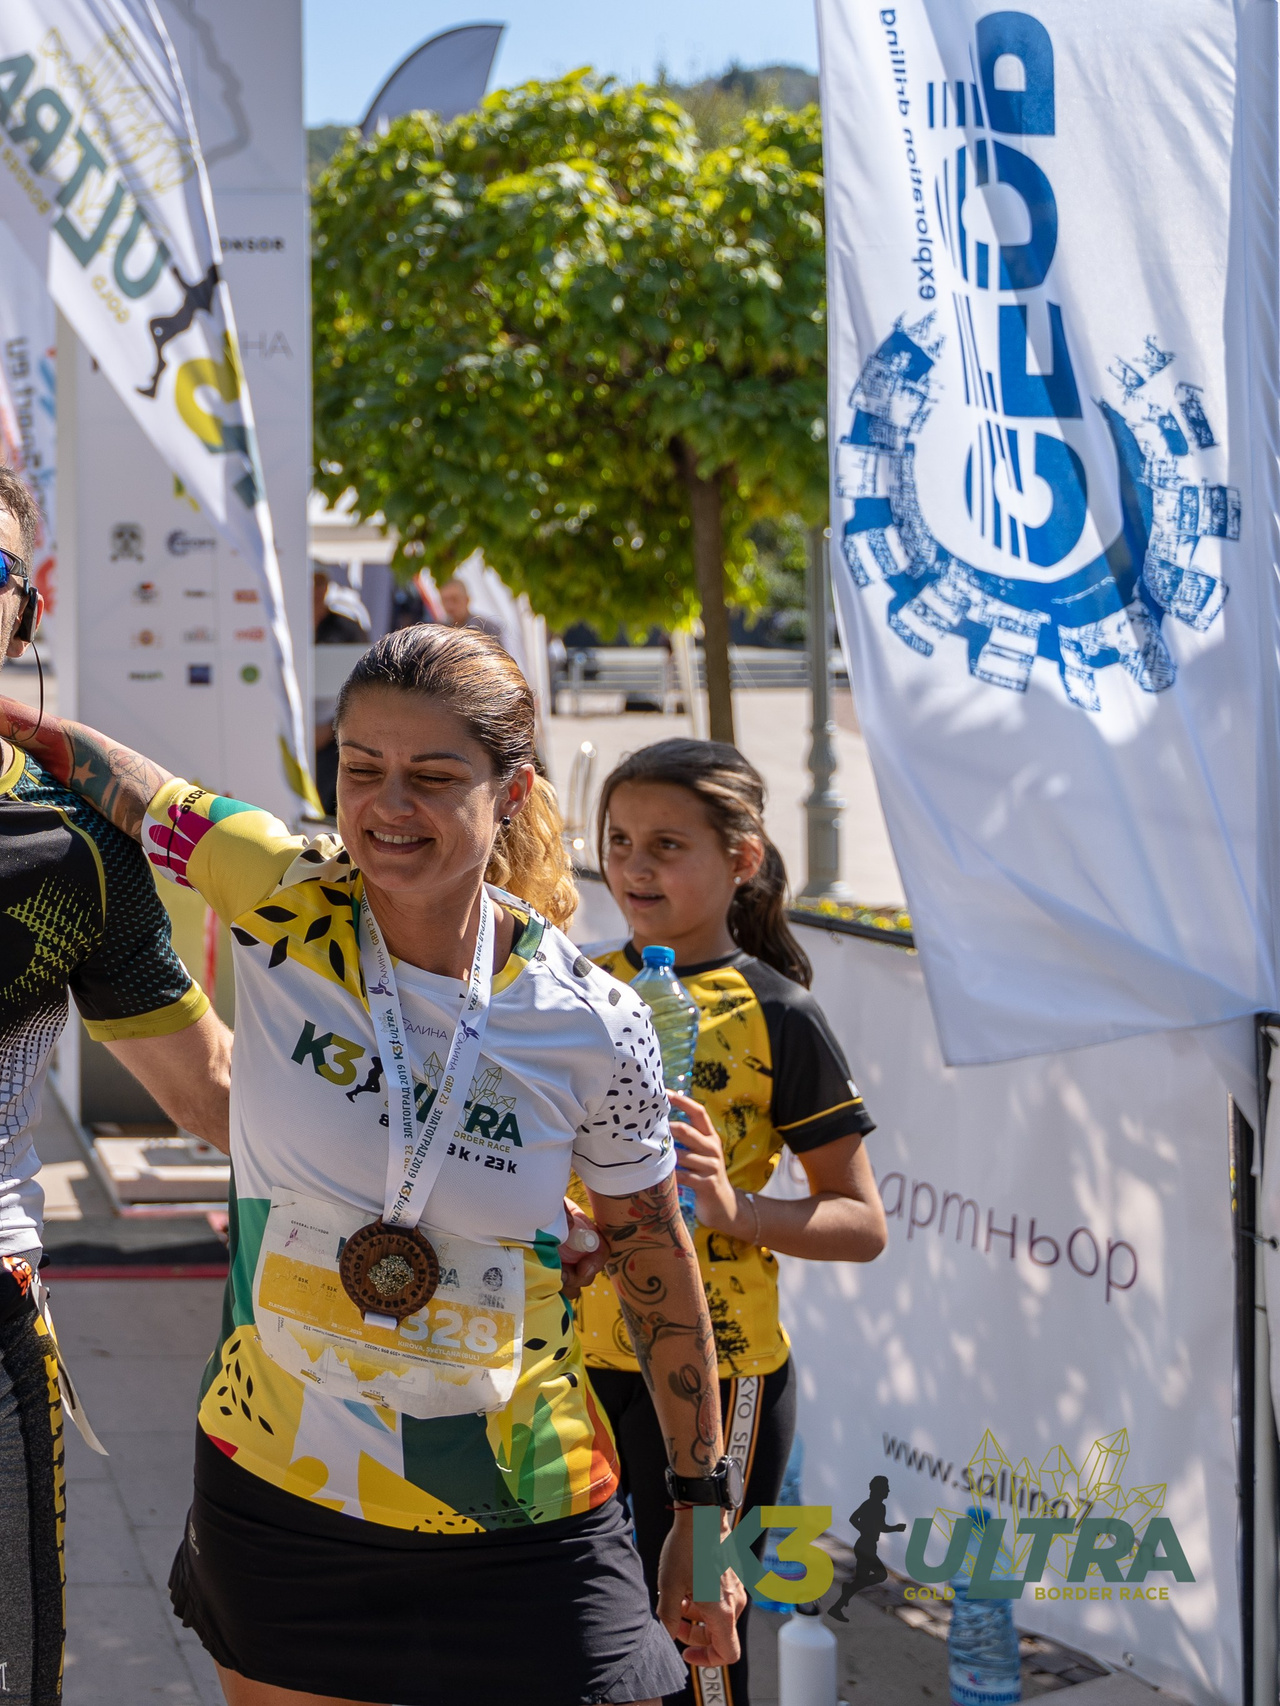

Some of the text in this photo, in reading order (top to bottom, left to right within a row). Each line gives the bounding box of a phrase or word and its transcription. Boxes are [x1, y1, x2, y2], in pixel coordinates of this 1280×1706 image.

[220, 237, 285, 253] ONSOR
[291, 1019, 366, 1087] K3
[400, 1063, 410, 1086] 2019
[454, 1130, 511, 1154] ORDER RACE
[407, 1156, 423, 1180] 2019
[484, 1155, 505, 1171] 23
[507, 1160, 518, 1175] k
[877, 1171, 1138, 1303] артньор
[399, 1305, 498, 1354] 328
